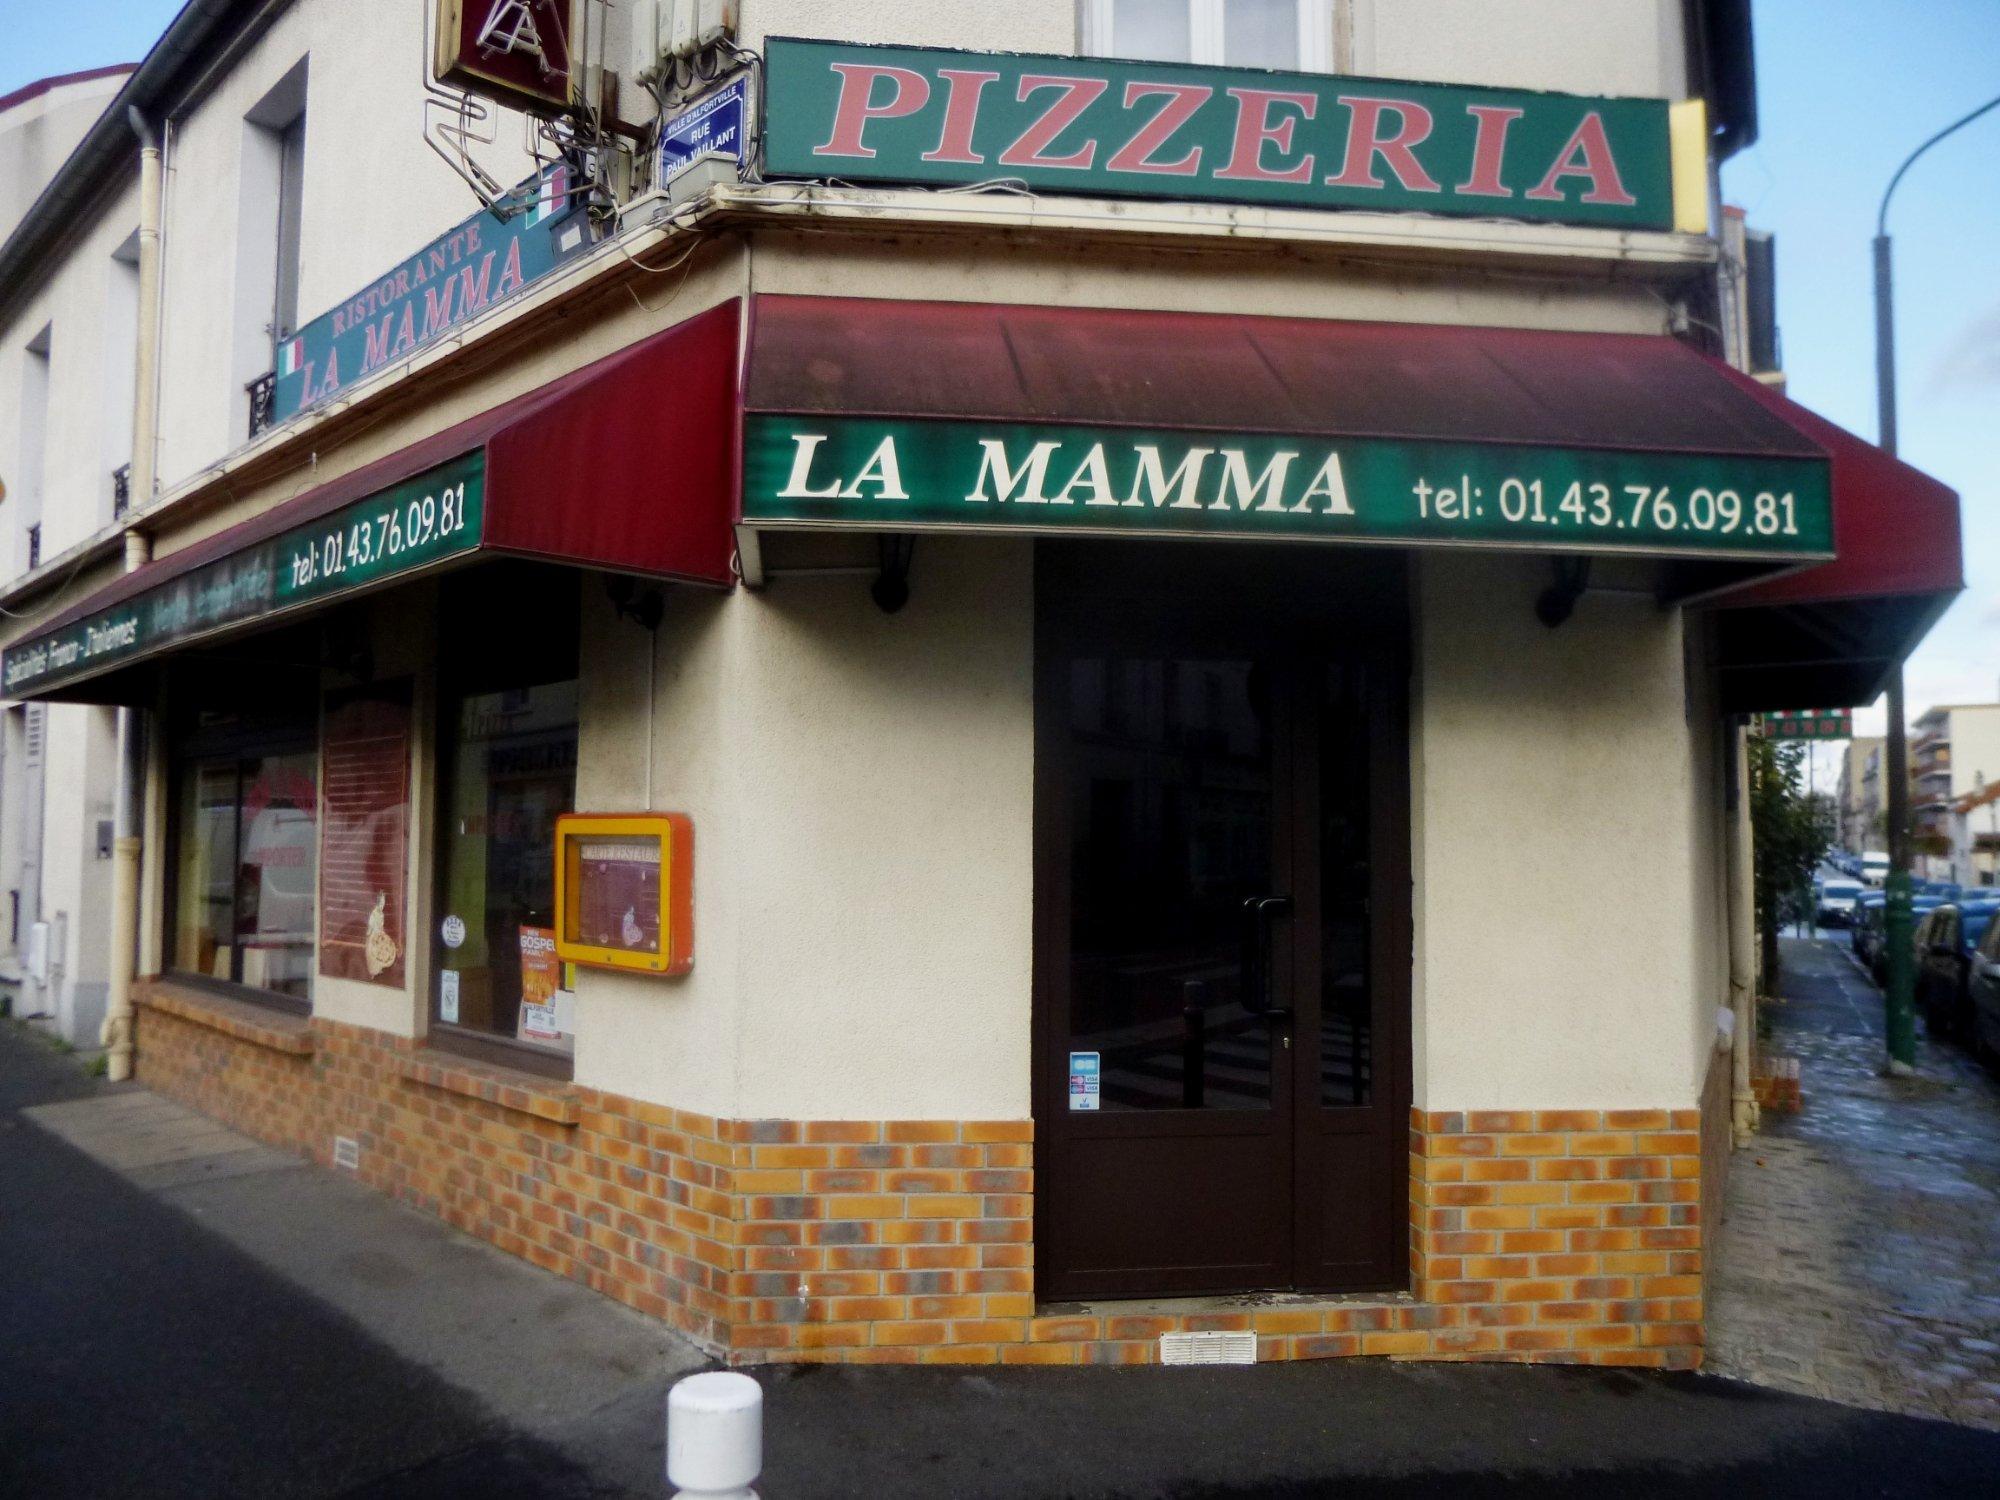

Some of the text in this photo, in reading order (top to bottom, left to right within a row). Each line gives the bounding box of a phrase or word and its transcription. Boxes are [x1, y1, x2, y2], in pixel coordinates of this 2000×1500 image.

[667, 85, 737, 135] VILLE D'ALFORTVILLE
[667, 125, 736, 174] PAUL VAILLANT
[691, 121, 711, 144] RUE
[812, 62, 1636, 206] PIZZERIA
[300, 235, 525, 410] LA MAMMA
[331, 222, 483, 339] RISTORANTE
[292, 541, 319, 588] tel:
[323, 482, 465, 578] 01.43.76.09.81
[776, 434, 1799, 536] LA MAMMA tel: 01.43.76.09.81
[520, 934, 556, 951] GOSPEL
